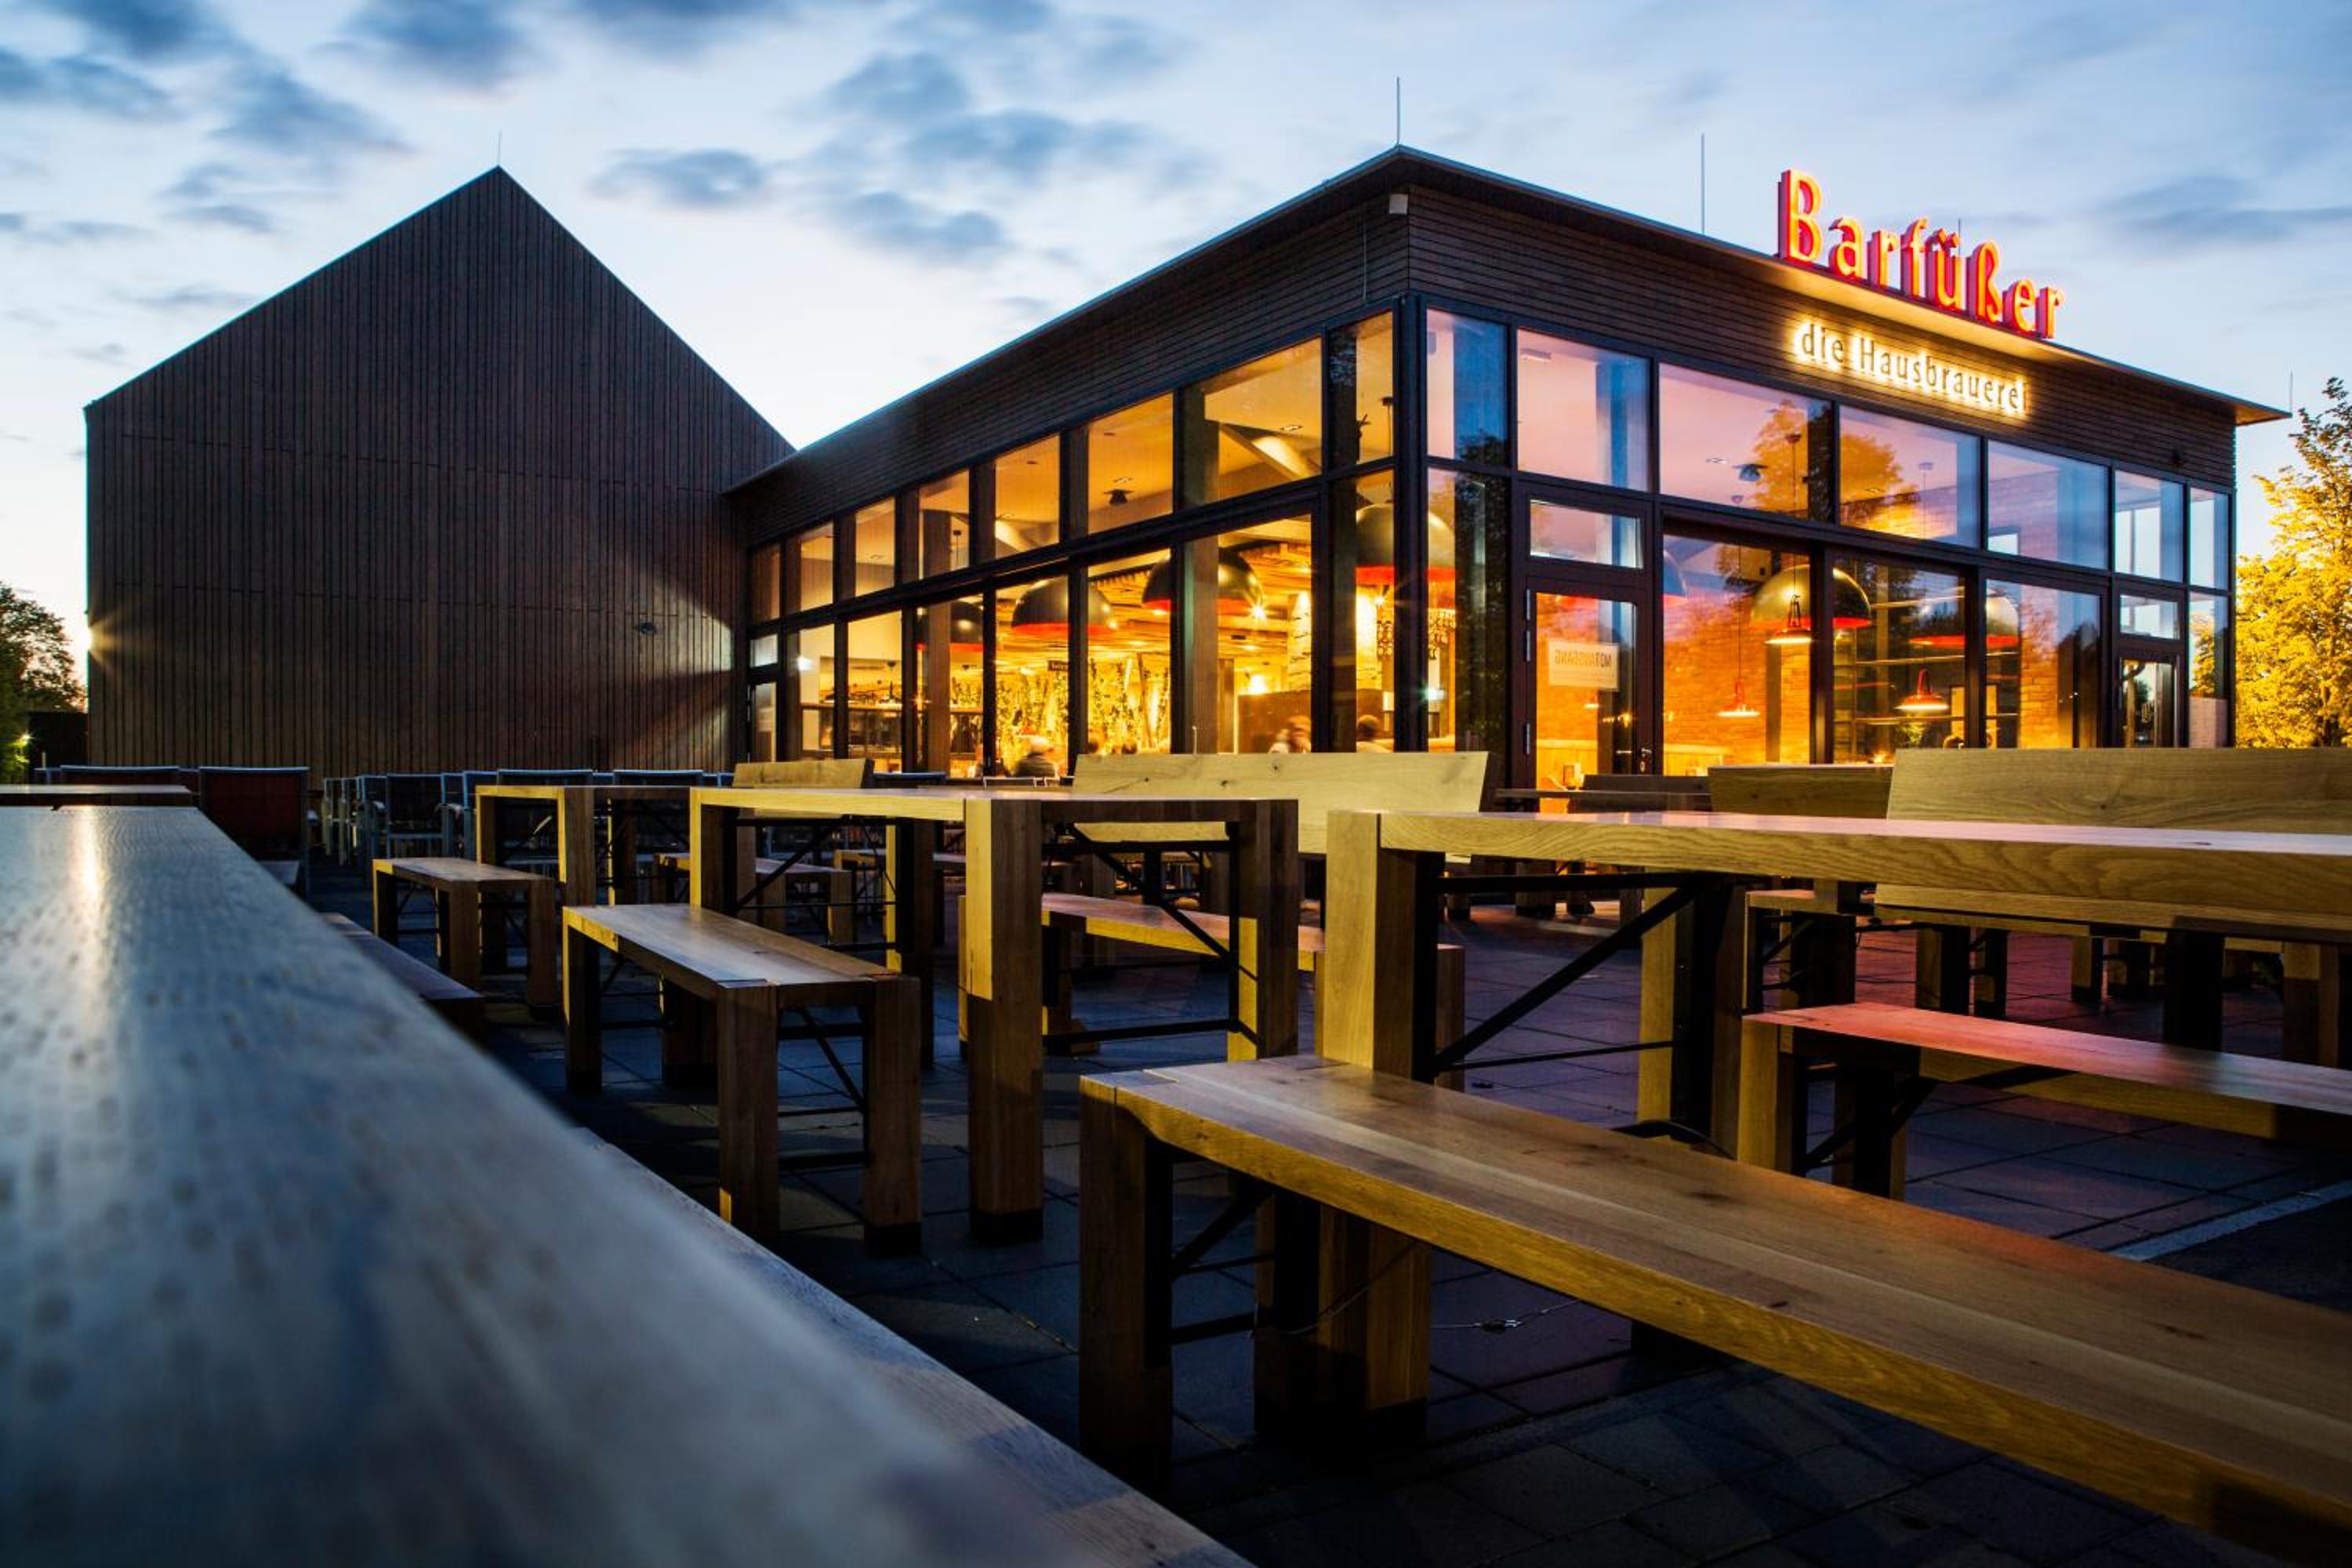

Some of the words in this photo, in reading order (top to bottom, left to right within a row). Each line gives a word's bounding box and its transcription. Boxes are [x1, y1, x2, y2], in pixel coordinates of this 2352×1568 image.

[1779, 169, 2063, 339] Barfüßer
[1802, 323, 1843, 363] die
[1860, 337, 2028, 412] Hausbrauerei
